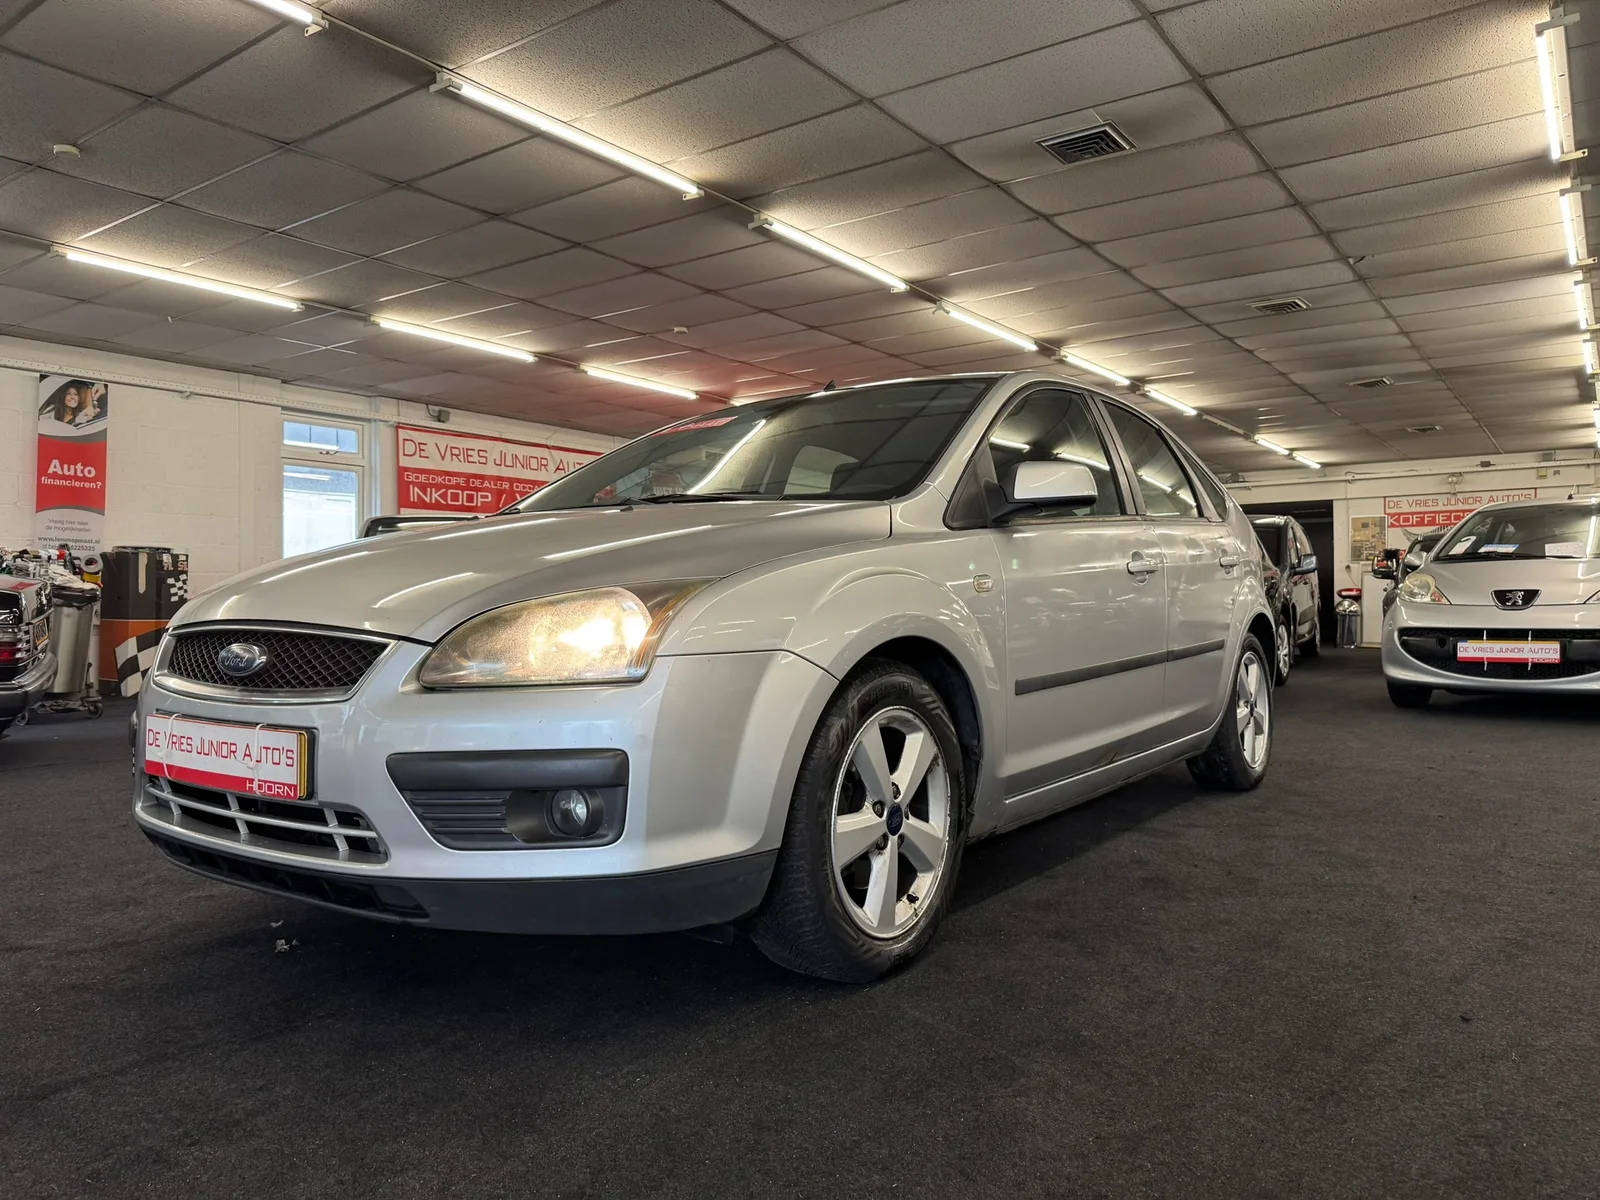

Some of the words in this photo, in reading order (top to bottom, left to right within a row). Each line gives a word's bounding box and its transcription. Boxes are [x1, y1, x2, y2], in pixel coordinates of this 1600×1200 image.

[402, 438, 430, 459] DE
[434, 442, 488, 465] VRIES
[493, 449, 549, 473] JUNIOR
[48, 459, 96, 478] Auto
[41, 476, 102, 489] financieren?
[404, 472, 466, 486] GOEDKOPE
[470, 478, 509, 490] DEALER
[409, 484, 492, 507] INKOOP
[1388, 500, 1402, 509] DE
[1407, 498, 1439, 508] VRIES
[1442, 496, 1482, 506] JUNIOR
[224, 650, 248, 667] Ford
[147, 729, 161, 748] DE
[164, 731, 193, 754] VRIES
[196, 736, 238, 760] JUNIOR
[242, 742, 294, 767] AUTO'S
[246, 780, 294, 798] HOORN
